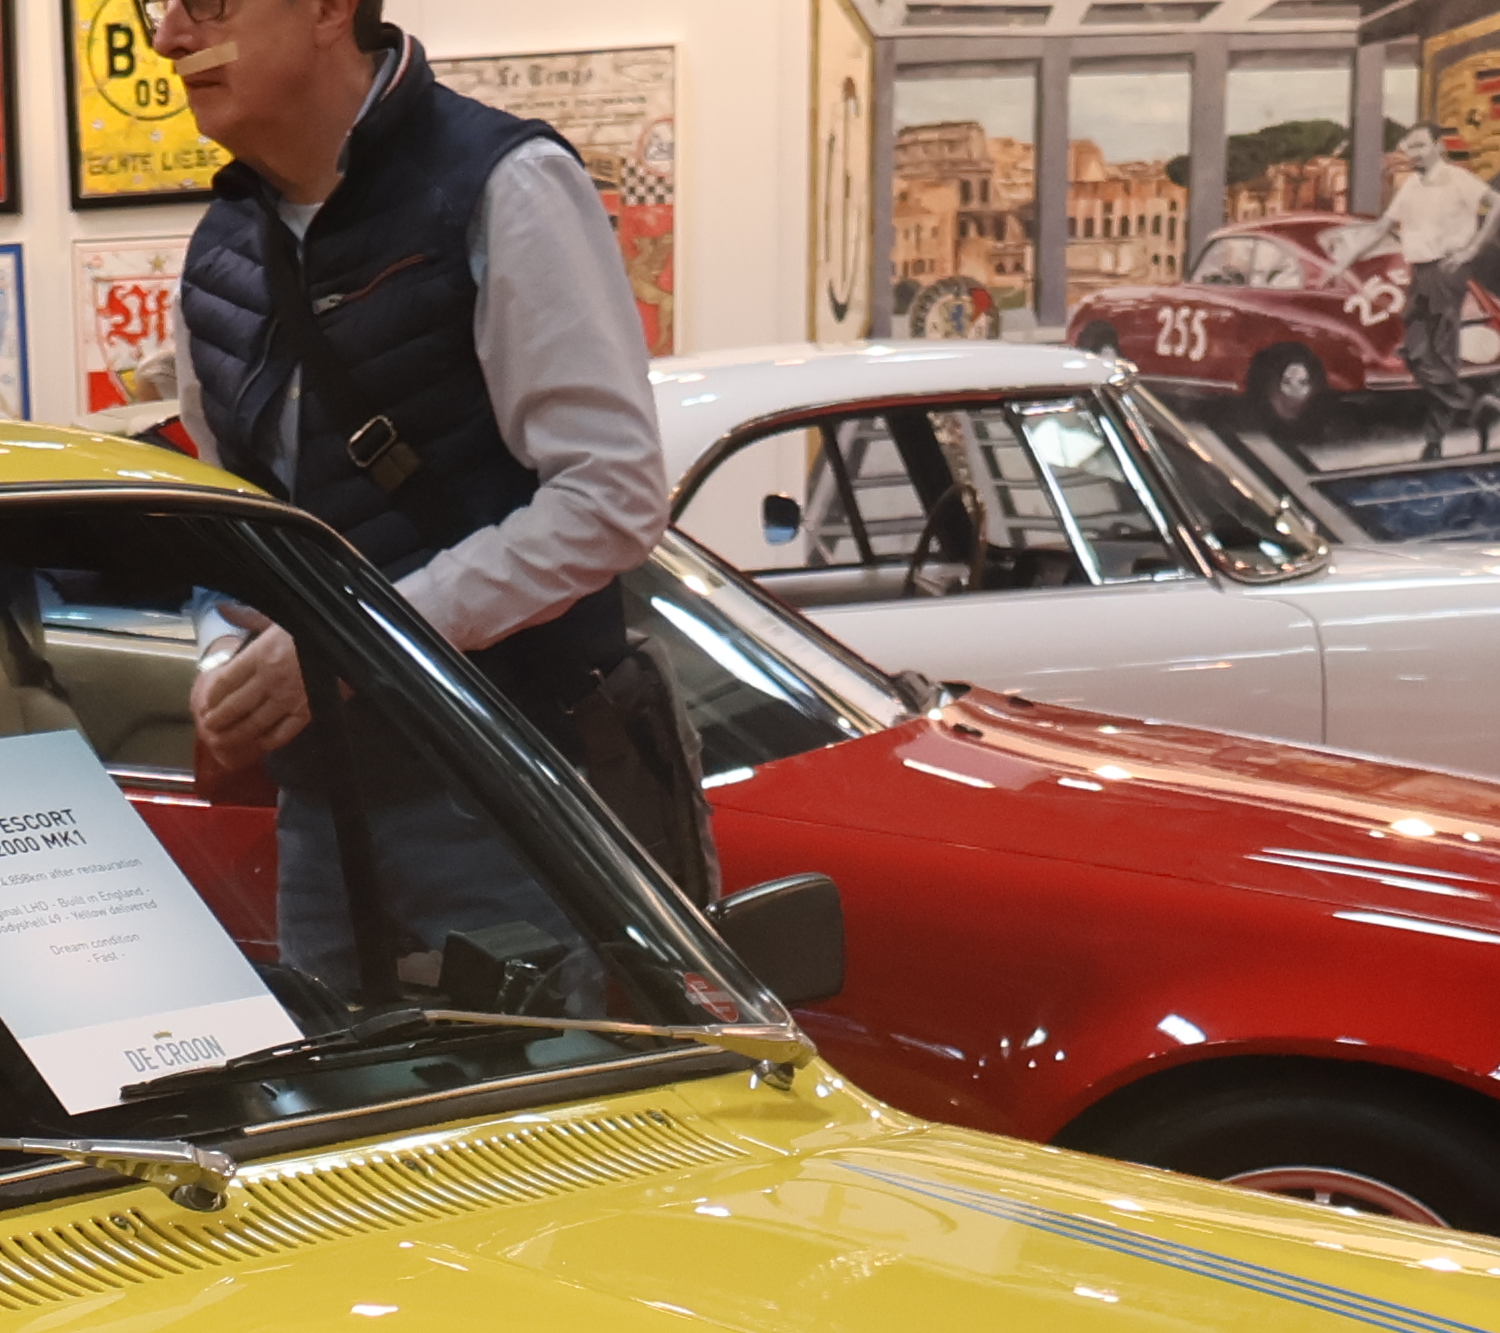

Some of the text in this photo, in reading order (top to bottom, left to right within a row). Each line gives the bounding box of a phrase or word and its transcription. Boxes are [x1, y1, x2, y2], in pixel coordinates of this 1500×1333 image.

[135, 78, 170, 108] 09
[40, 828, 88, 851] MK1
[48, 867, 75, 881] after
[97, 886, 145, 903] England
[108, 898, 158, 916] delivered
[49, 932, 141, 957] Dream condition
[123, 1033, 227, 1073] DE CROON
